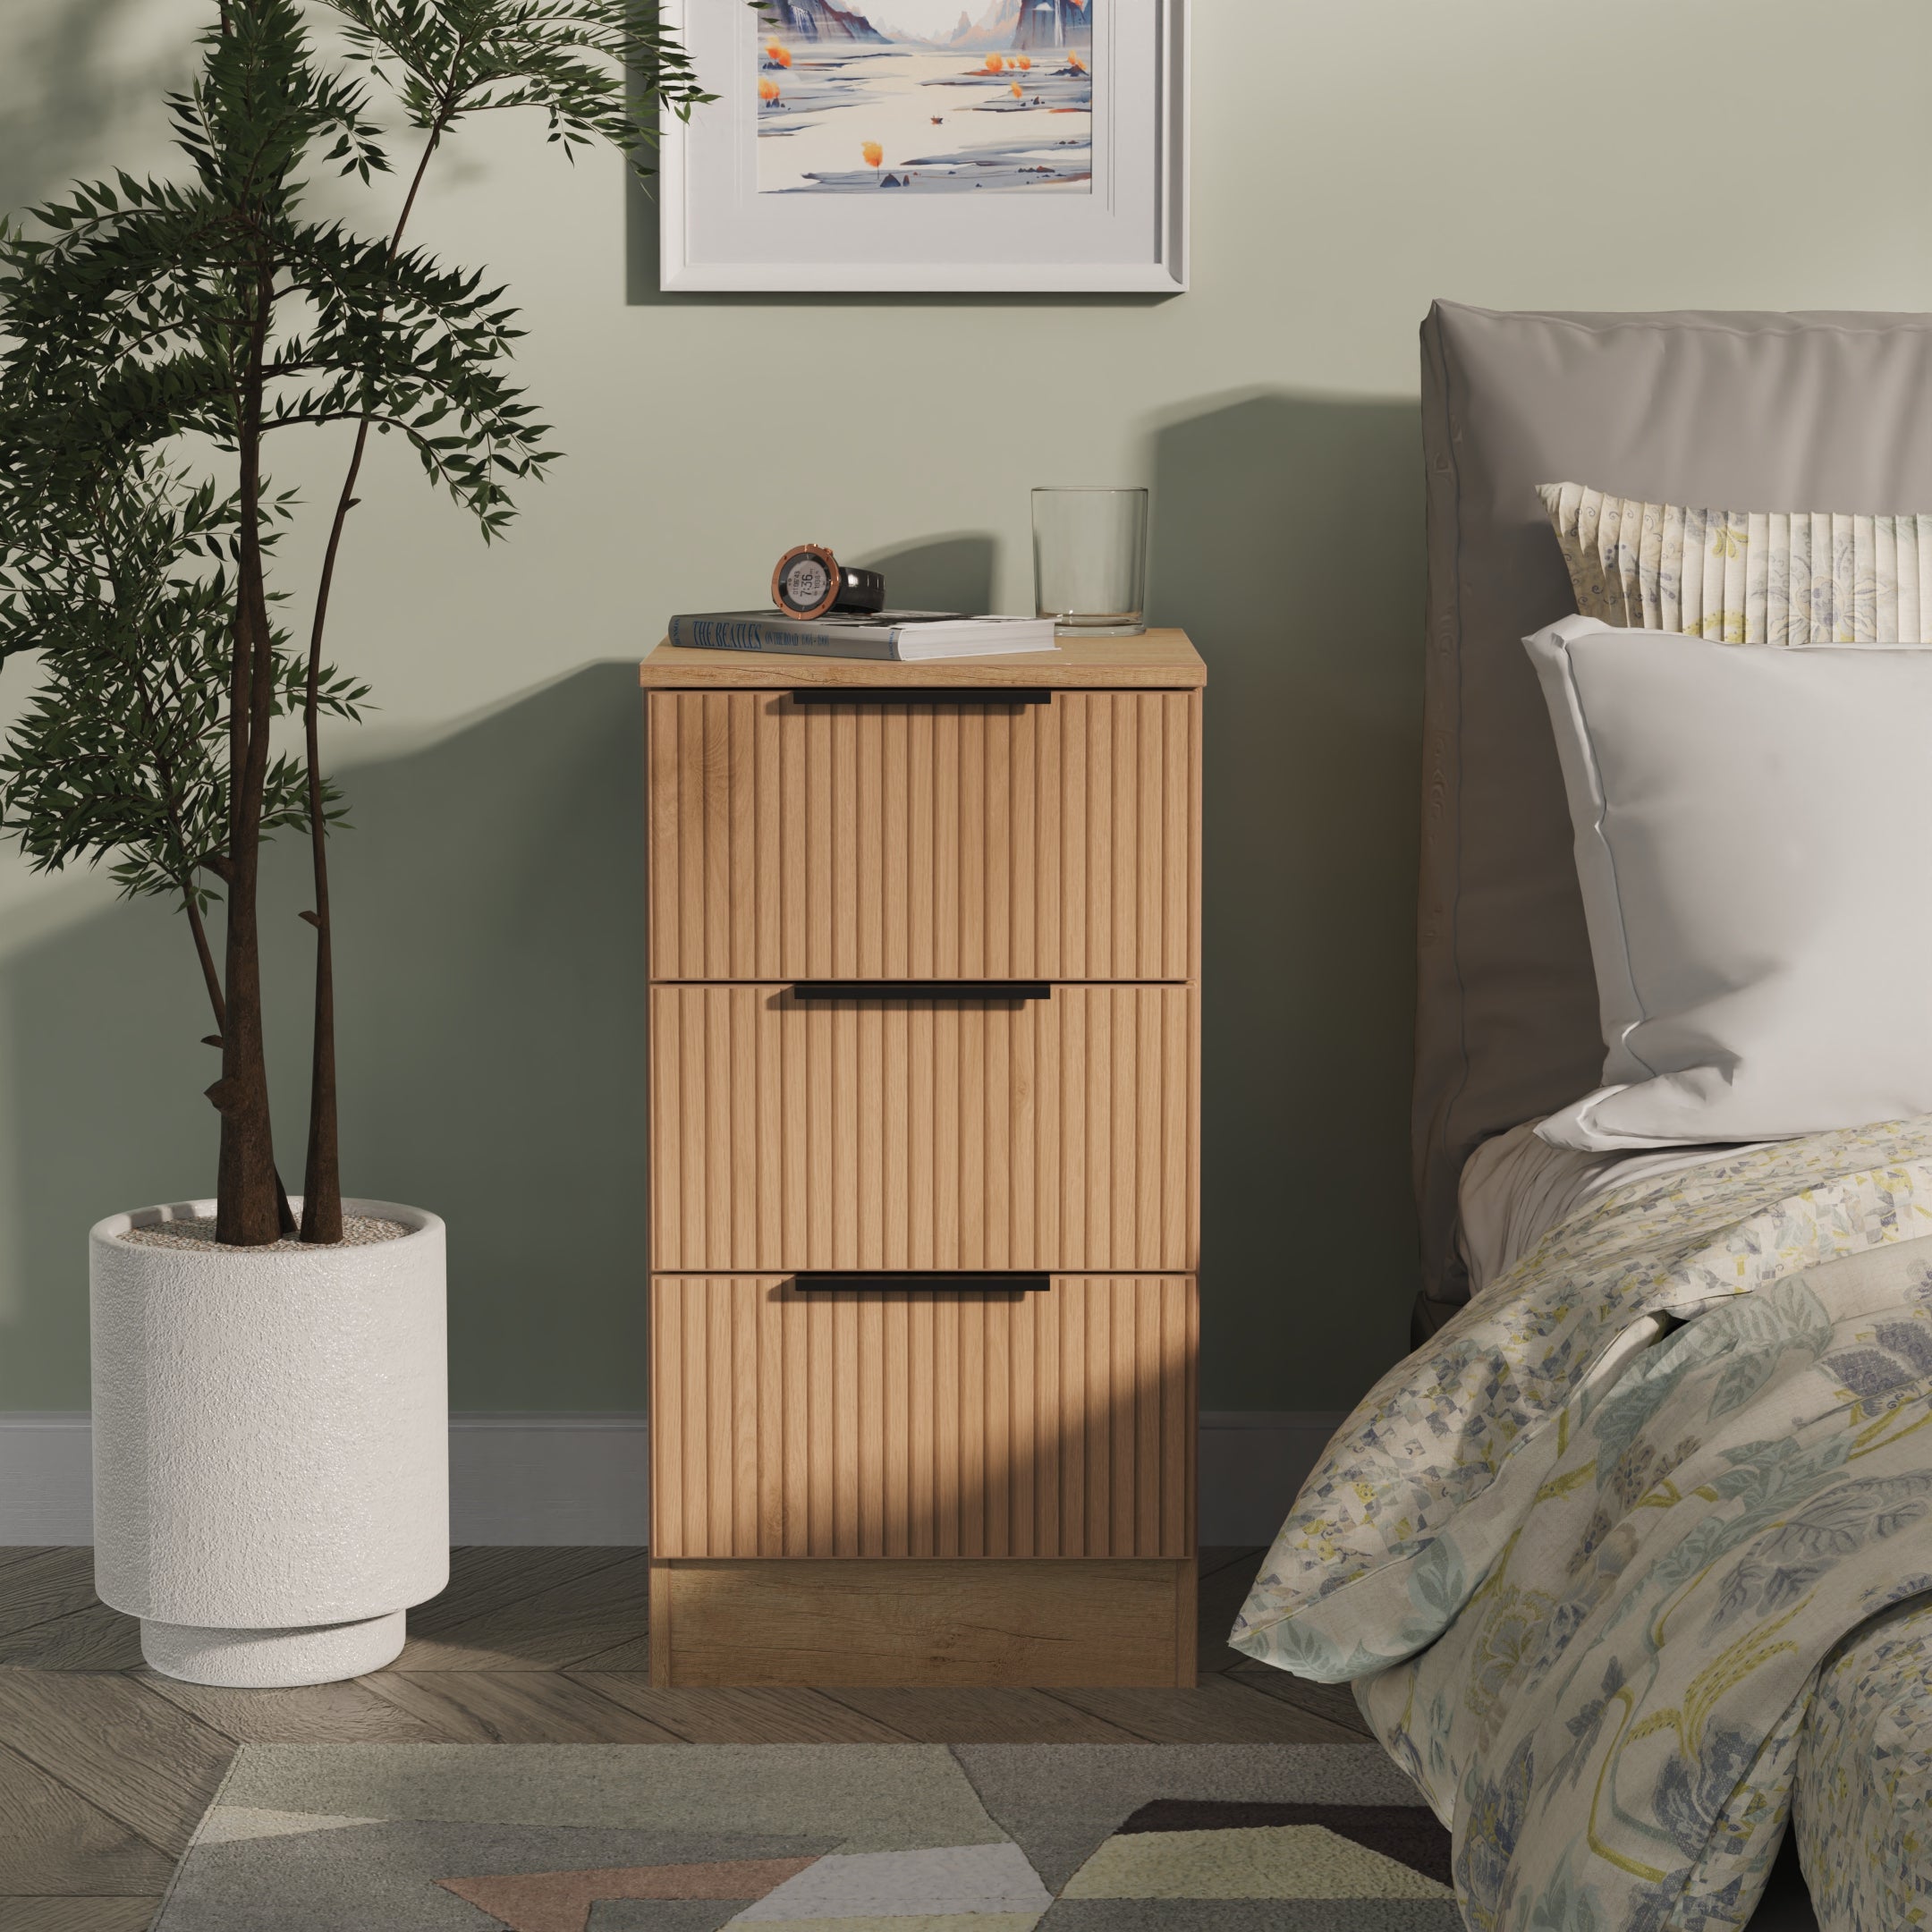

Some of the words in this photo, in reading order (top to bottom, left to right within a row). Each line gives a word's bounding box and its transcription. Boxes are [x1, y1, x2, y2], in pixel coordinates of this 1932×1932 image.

[800, 574, 813, 597] 7:36
[693, 621, 715, 646] THE
[716, 623, 762, 649] BEATLES
